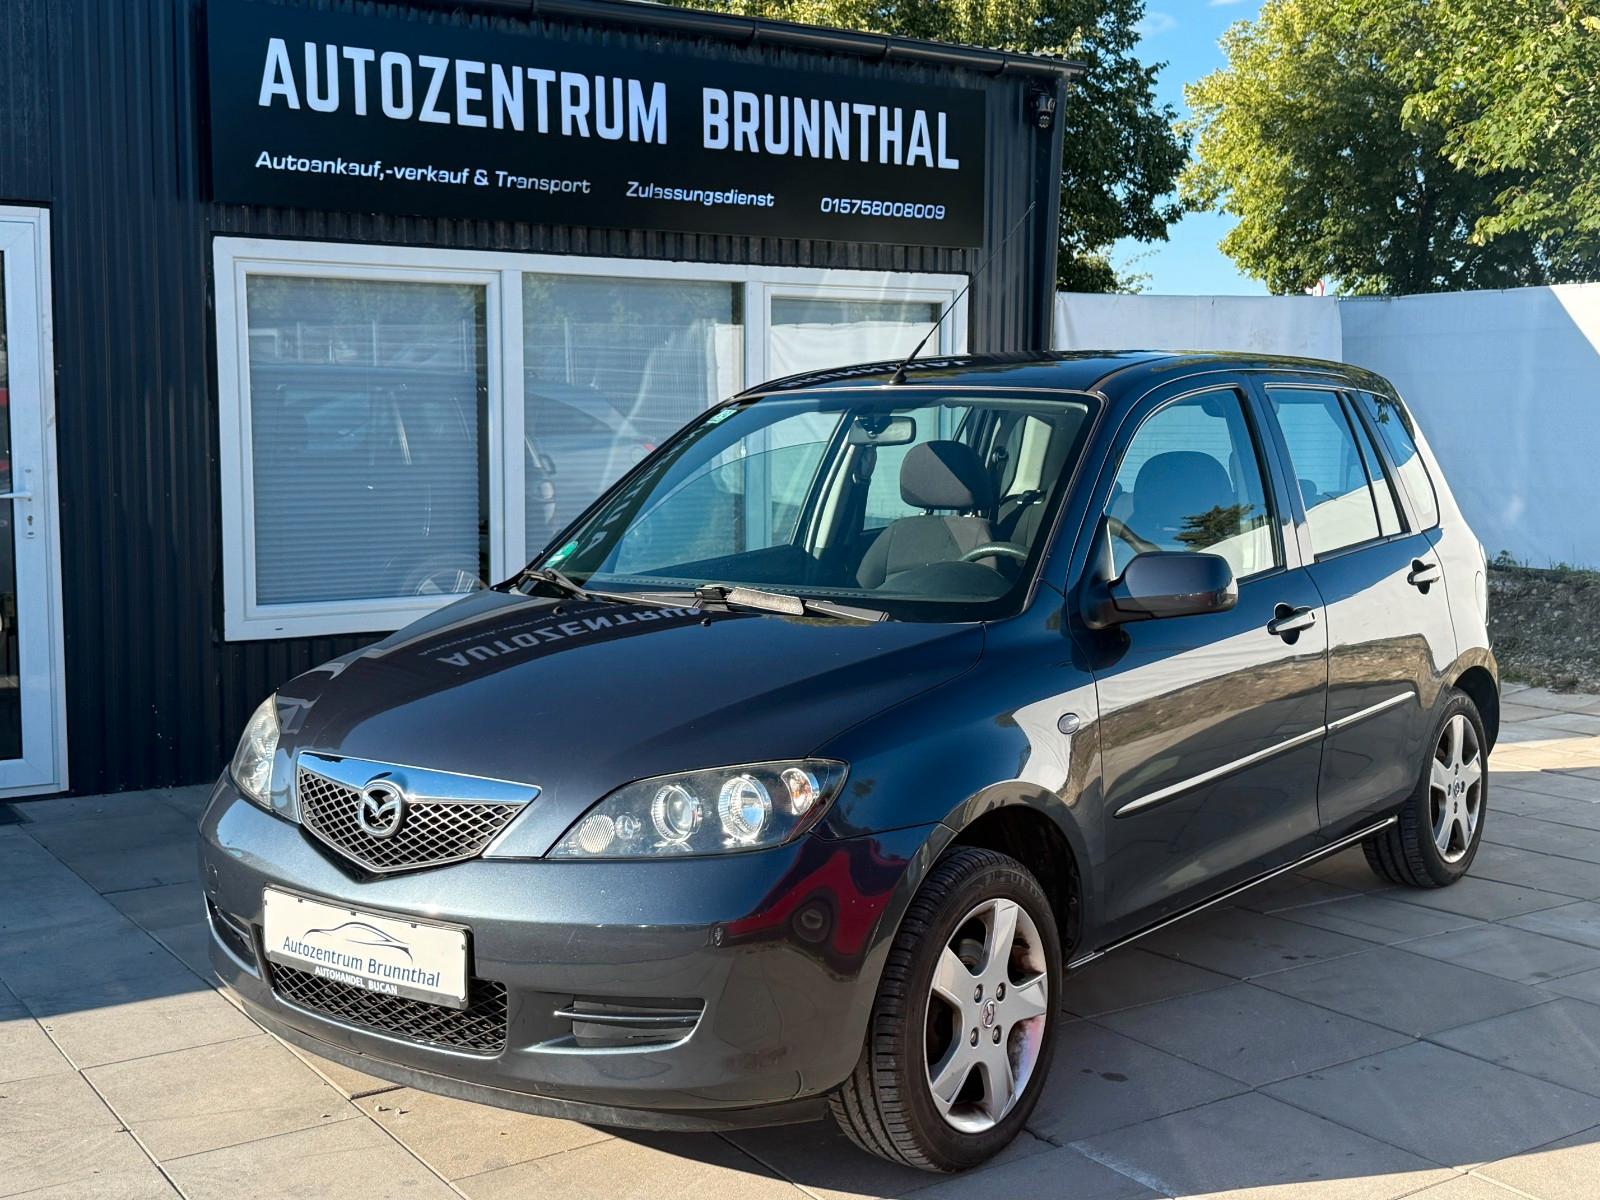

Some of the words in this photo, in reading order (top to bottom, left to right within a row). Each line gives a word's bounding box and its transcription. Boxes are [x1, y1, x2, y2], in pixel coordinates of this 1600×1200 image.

[259, 38, 666, 144] AUTOZENTRUM
[703, 88, 959, 169] BRUNNTHAL
[474, 169, 489, 185] &
[496, 171, 590, 194] Transport
[626, 182, 774, 206] Zulassungsdienst
[821, 198, 945, 219] 015758008009
[283, 936, 363, 971] Autozentrum
[367, 958, 441, 988] Brunnthal
[314, 966, 365, 989] AUTOHANDEL
[368, 981, 398, 995] BUCAN
